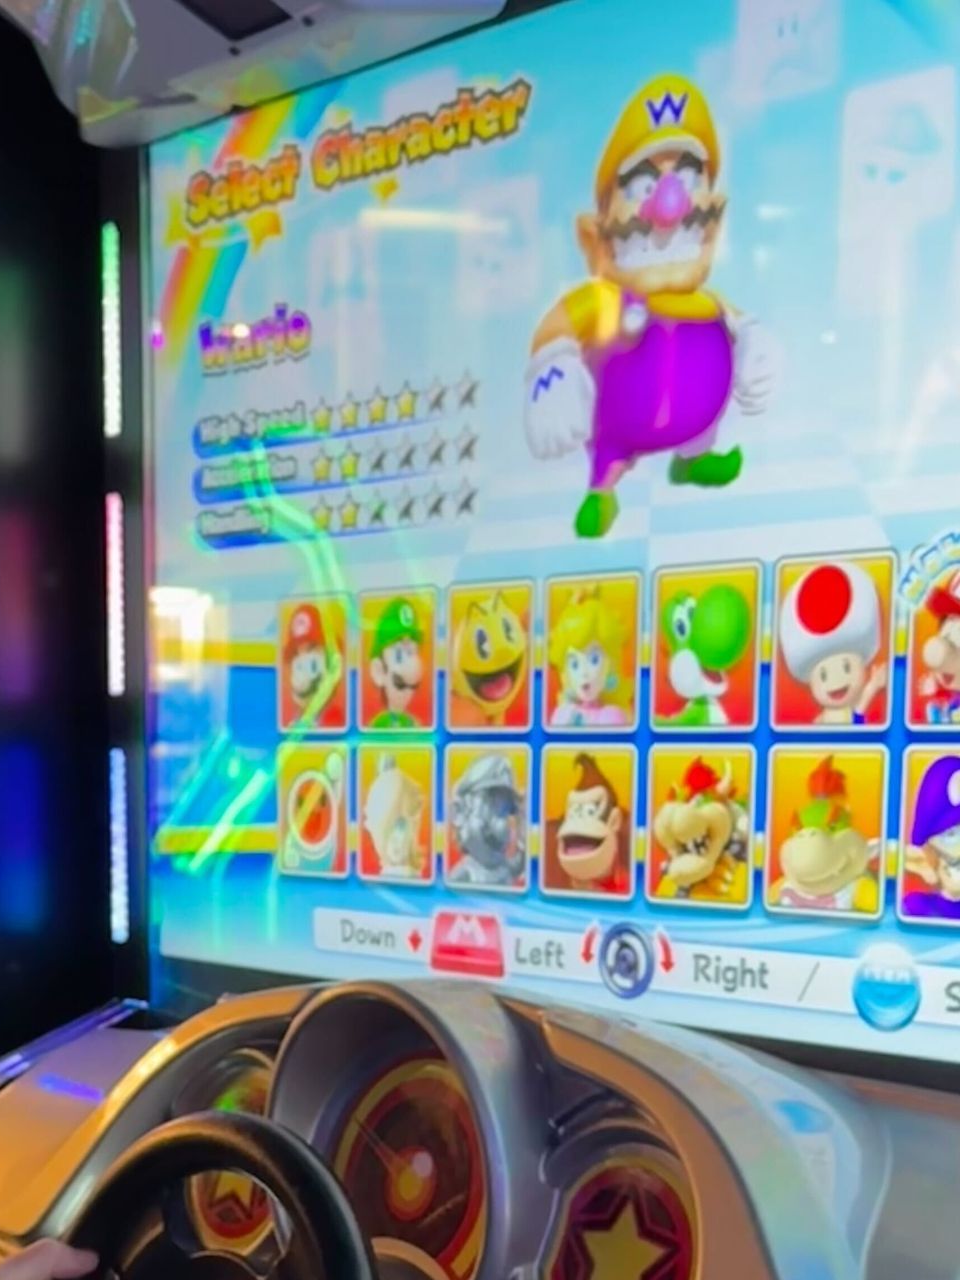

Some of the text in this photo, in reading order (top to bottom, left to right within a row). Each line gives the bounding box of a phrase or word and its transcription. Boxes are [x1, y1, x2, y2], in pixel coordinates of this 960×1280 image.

[186, 79, 532, 228] Select Character
[340, 919, 396, 949] Down
[514, 938, 566, 969] Left
[692, 953, 770, 993] Right
